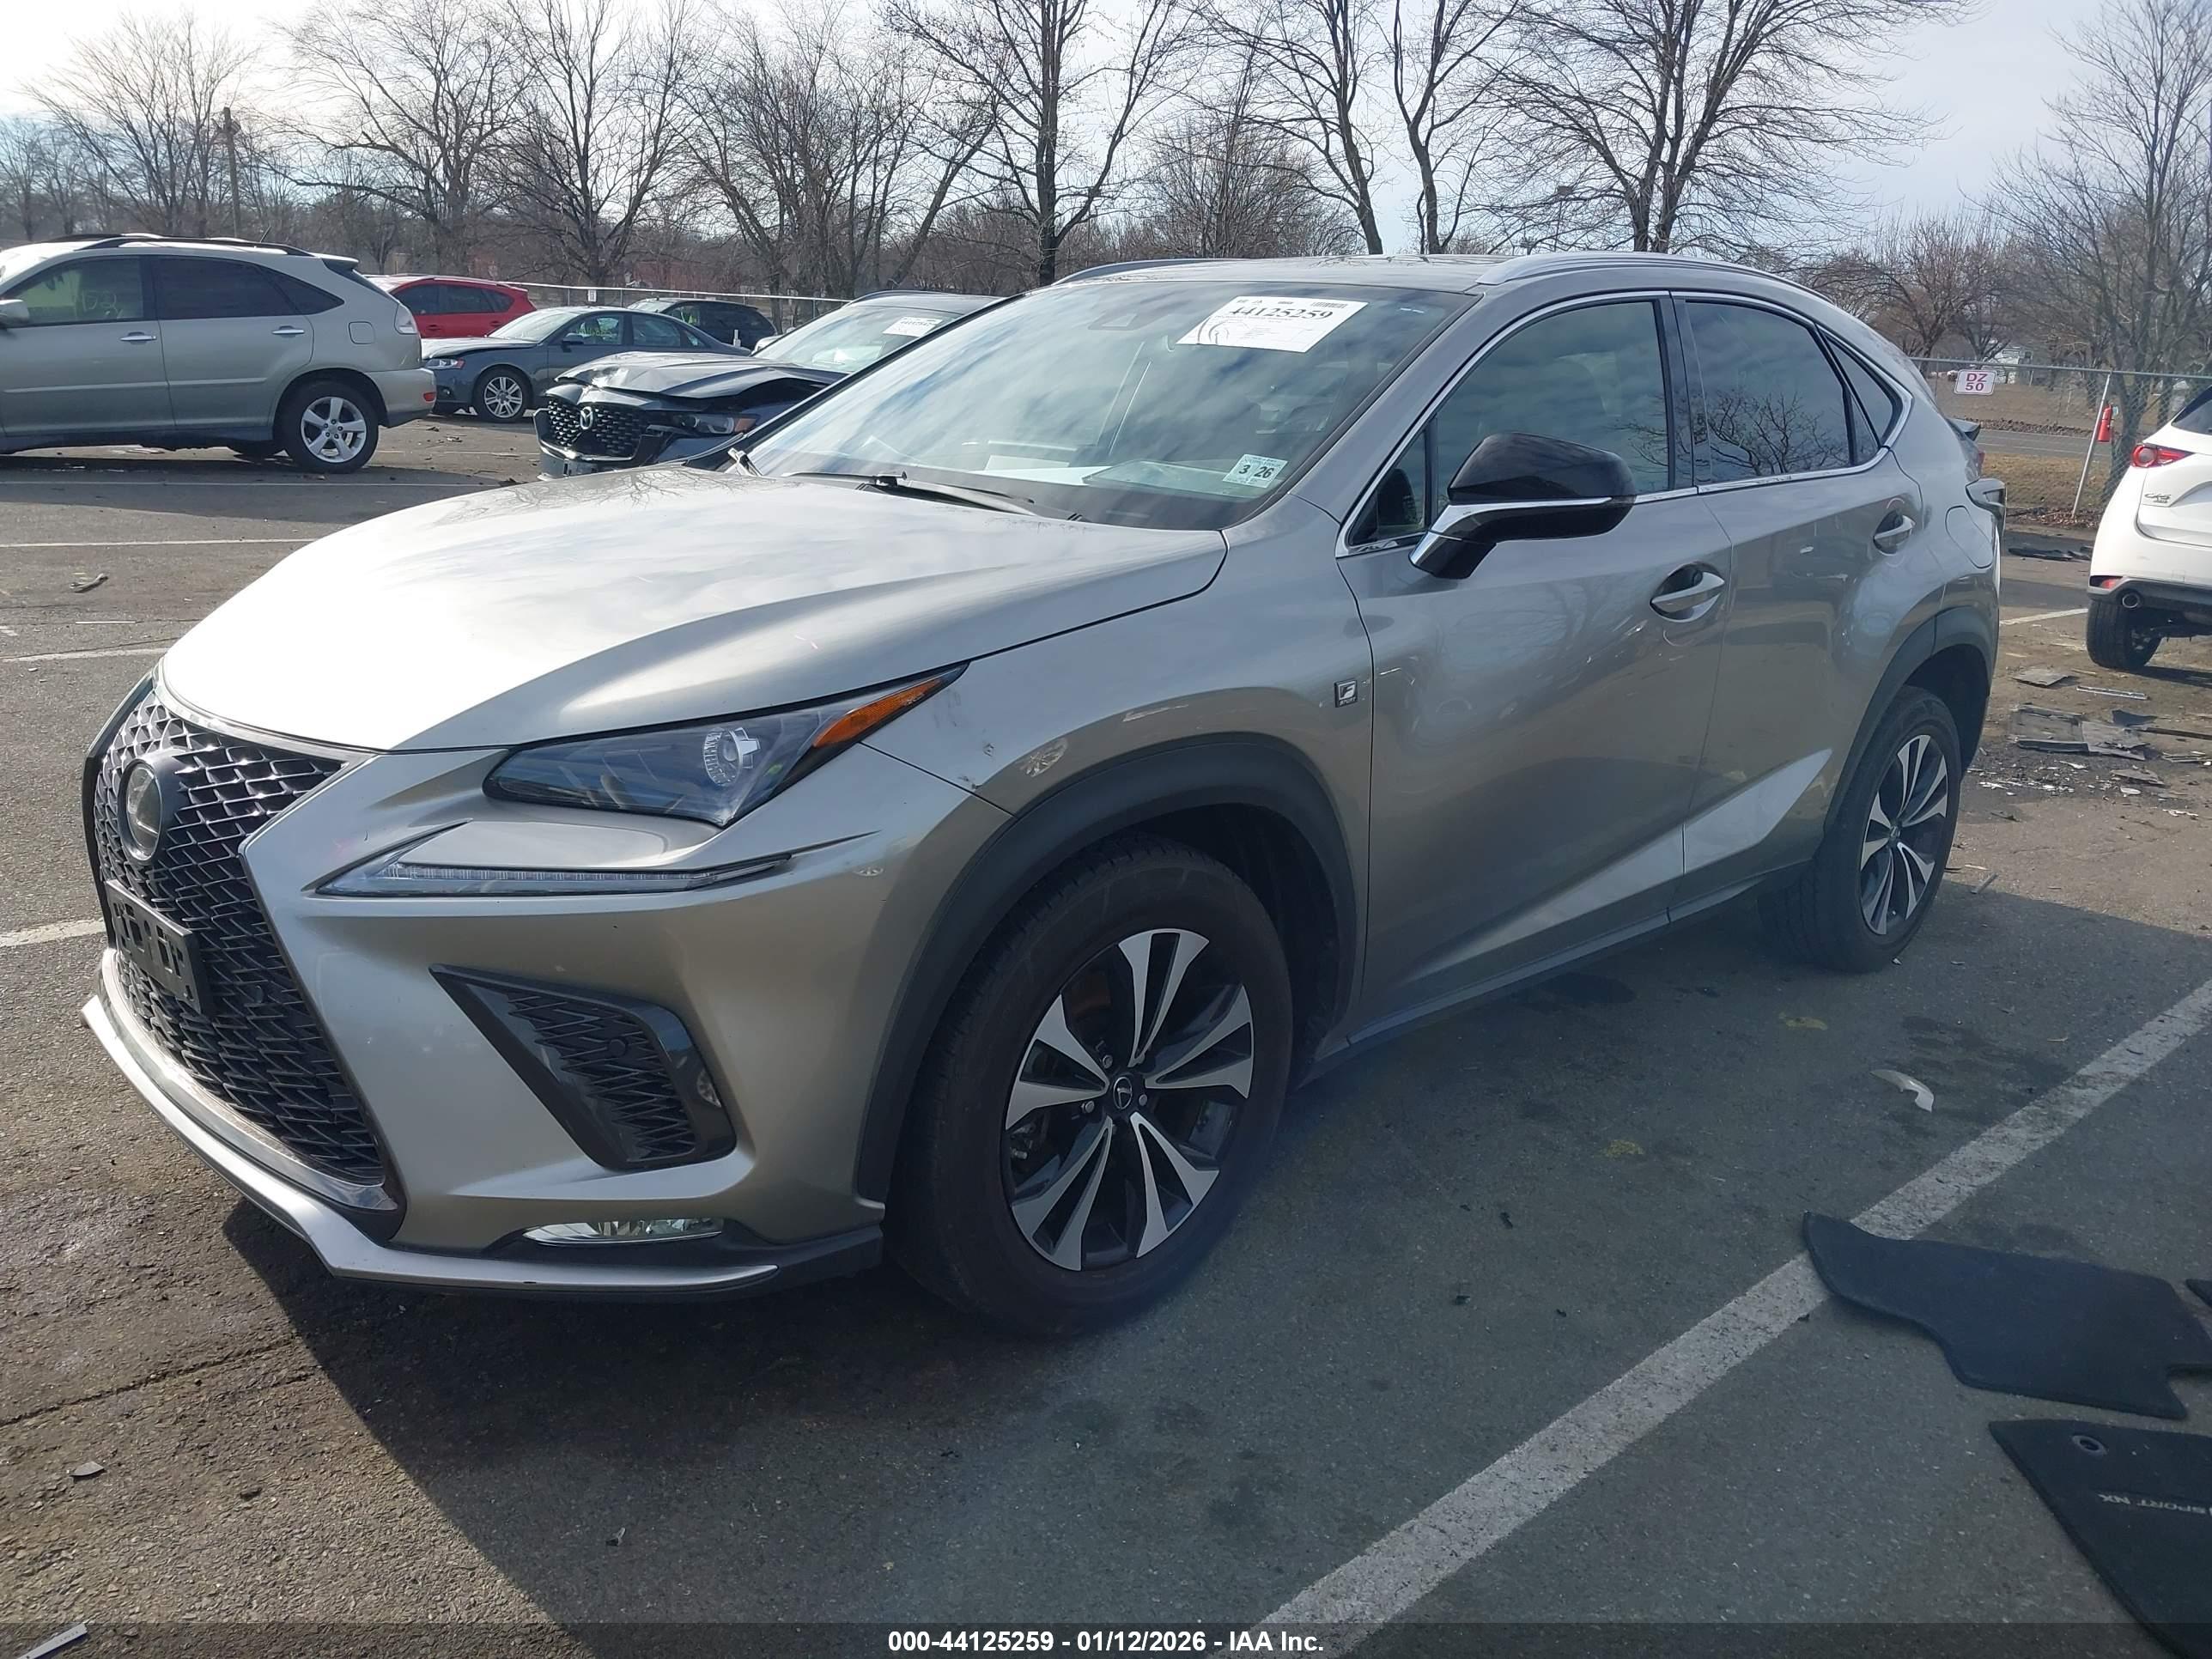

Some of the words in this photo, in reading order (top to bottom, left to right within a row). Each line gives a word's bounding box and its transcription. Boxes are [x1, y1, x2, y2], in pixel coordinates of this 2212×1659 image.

[1230, 307, 1334, 320] 44125259
[1966, 373, 1989, 383] DZ
[1965, 382, 1984, 392] 50
[1238, 464, 1251, 475] 3
[1254, 465, 1275, 479] 26
[2096, 1492, 2130, 1505] NX
[2136, 1498, 2207, 1515] SPORT
